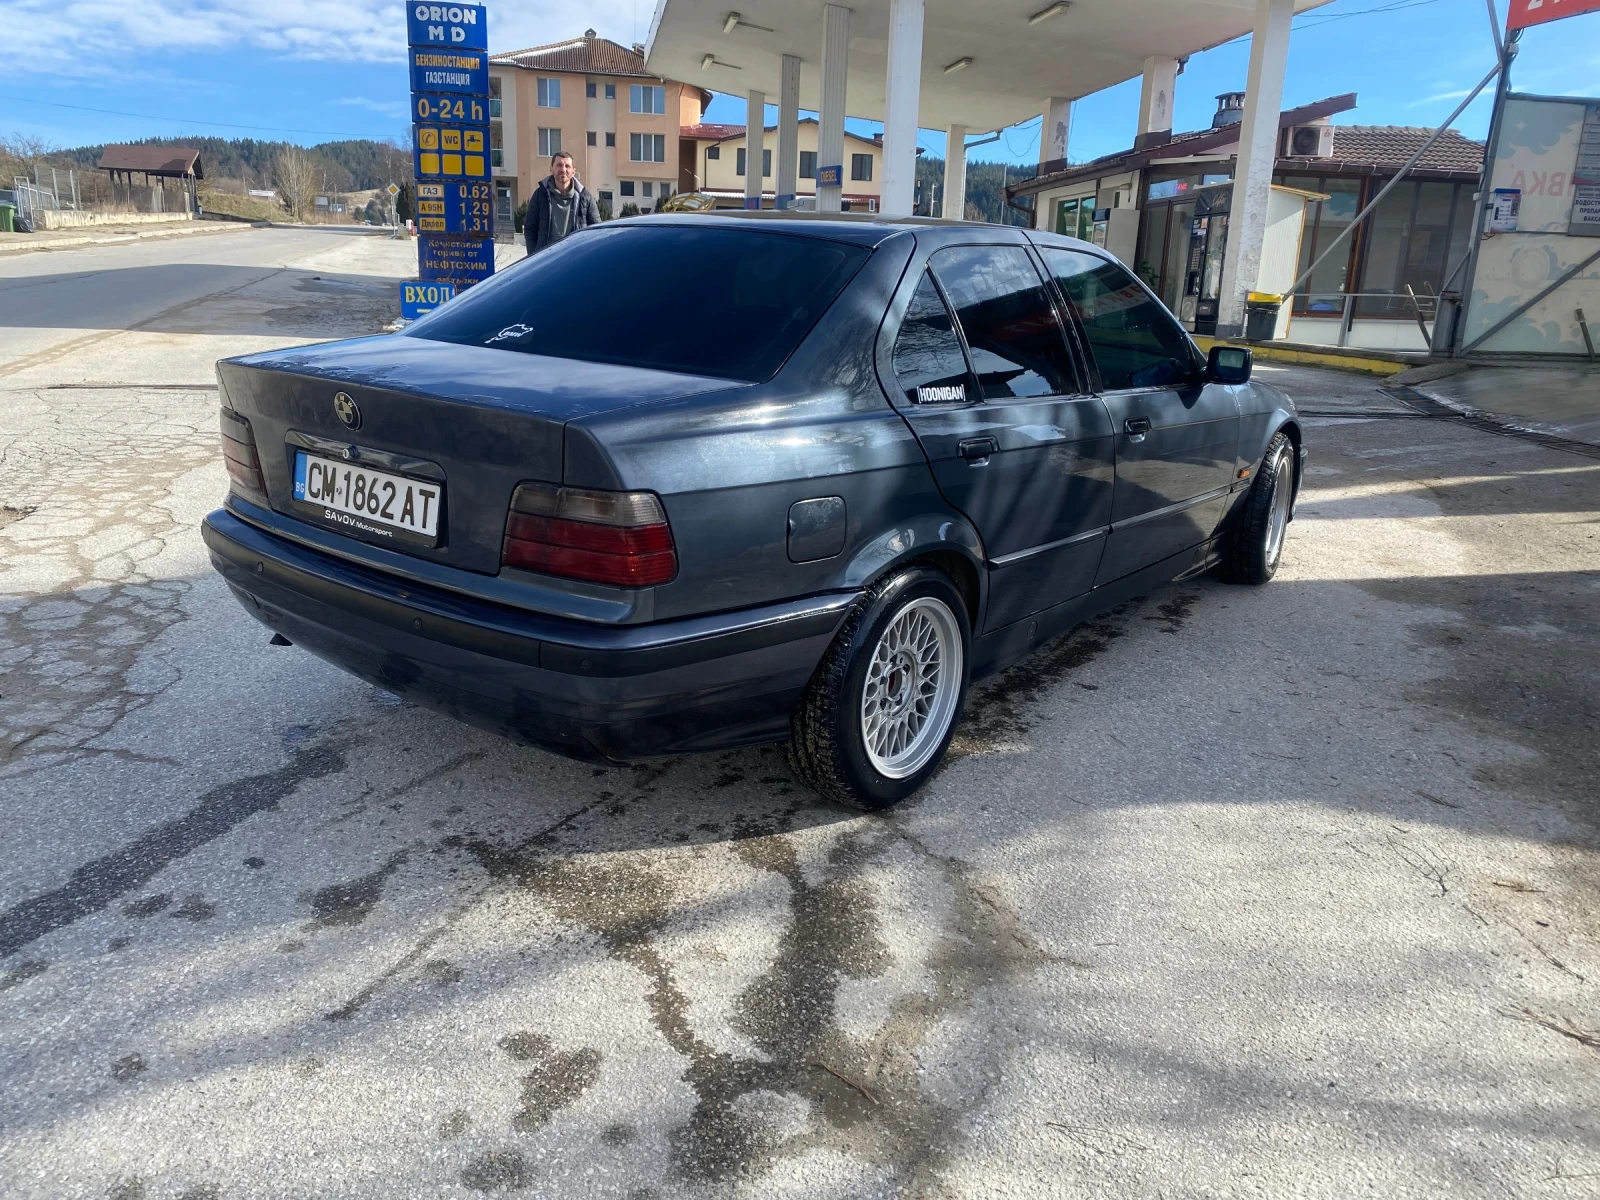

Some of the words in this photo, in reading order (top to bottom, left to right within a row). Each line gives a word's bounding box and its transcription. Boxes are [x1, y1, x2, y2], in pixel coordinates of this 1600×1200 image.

[415, 5, 477, 25] ORION
[428, 26, 444, 40] M
[450, 27, 465, 42] D
[415, 54, 480, 71] БЕНЗИНОСТАНЦИЯ
[425, 71, 470, 87] ГАЗСТАНЦИЯ
[417, 98, 465, 119] 0-24
[471, 101, 483, 120] h
[444, 135, 459, 145] WC
[820, 169, 838, 183] DIESEL
[423, 187, 438, 195] ГАЗ
[459, 184, 489, 199] 0.62
[459, 201, 490, 216] 1.29
[421, 219, 445, 229] Дизел
[461, 218, 489, 231] 1.31
[425, 259, 487, 270] НЕФТОХИМ
[405, 285, 450, 305] ВХОД
[295, 481, 305, 493] BG
[308, 461, 337, 504] CM
[343, 470, 397, 520] 1862
[400, 485, 436, 529] AT
